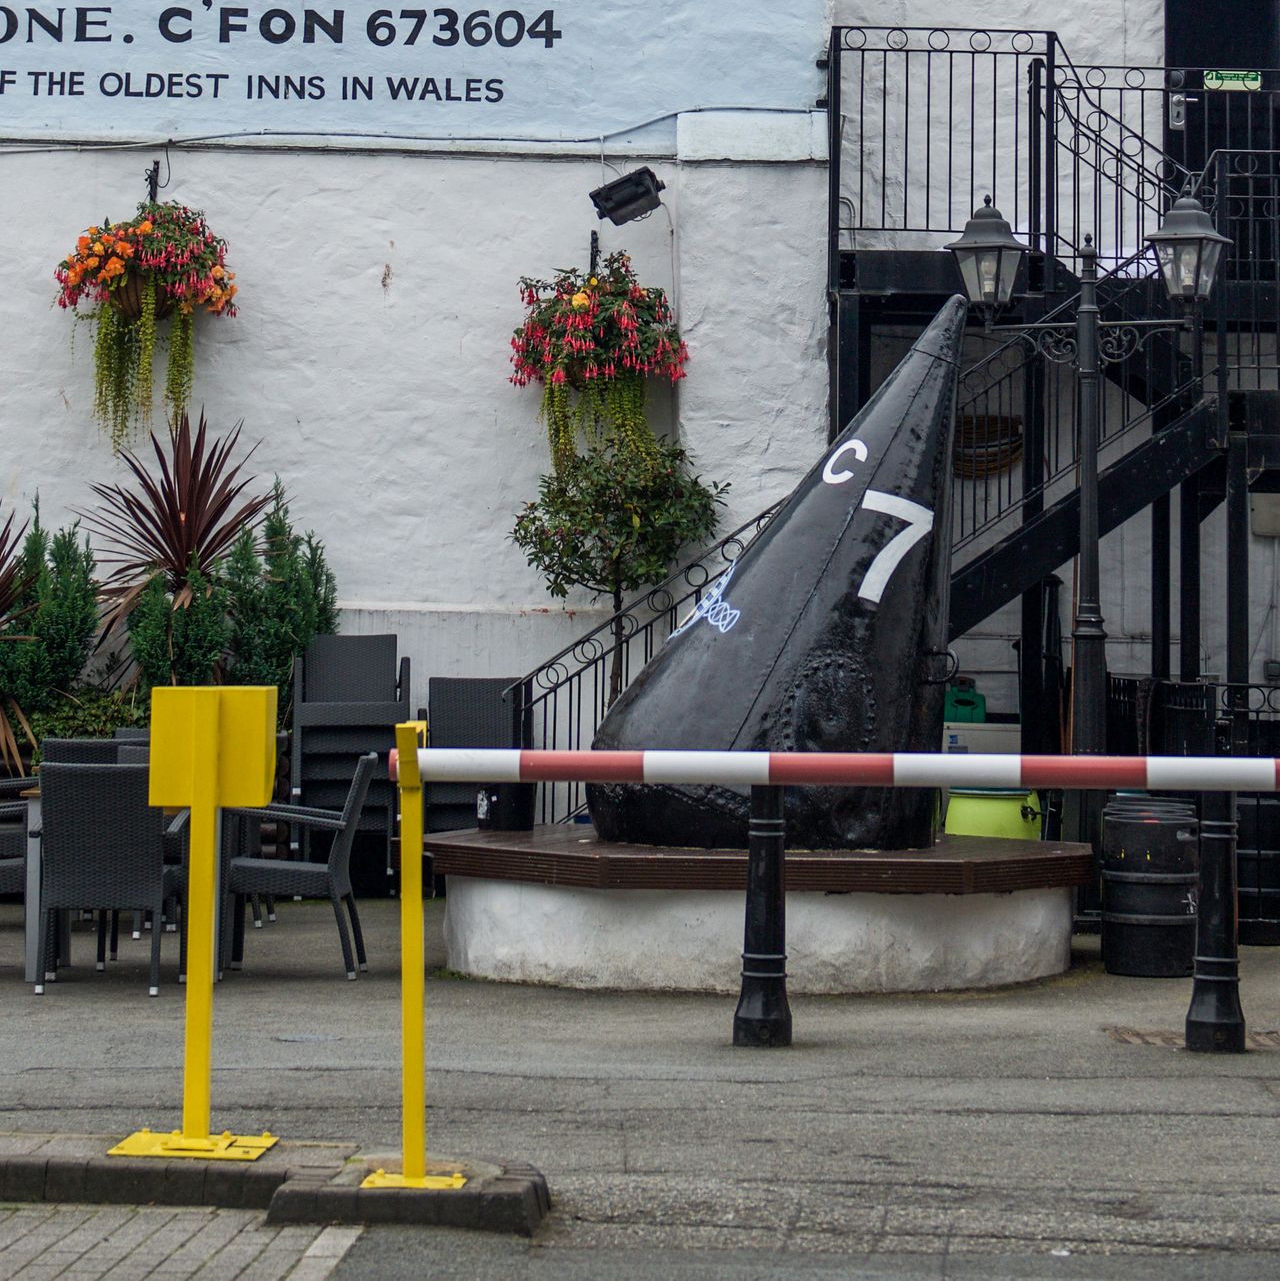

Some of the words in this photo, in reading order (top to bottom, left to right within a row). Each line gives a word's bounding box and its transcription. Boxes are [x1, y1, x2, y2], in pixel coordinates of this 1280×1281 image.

[367, 8, 562, 49] 673604
[28, 72, 85, 96] THE
[100, 73, 230, 99] OLDEST
[248, 75, 326, 100] INNS
[343, 77, 374, 101] IN
[386, 77, 504, 103] WALES
[822, 439, 868, 484] C
[857, 489, 935, 604] 7
